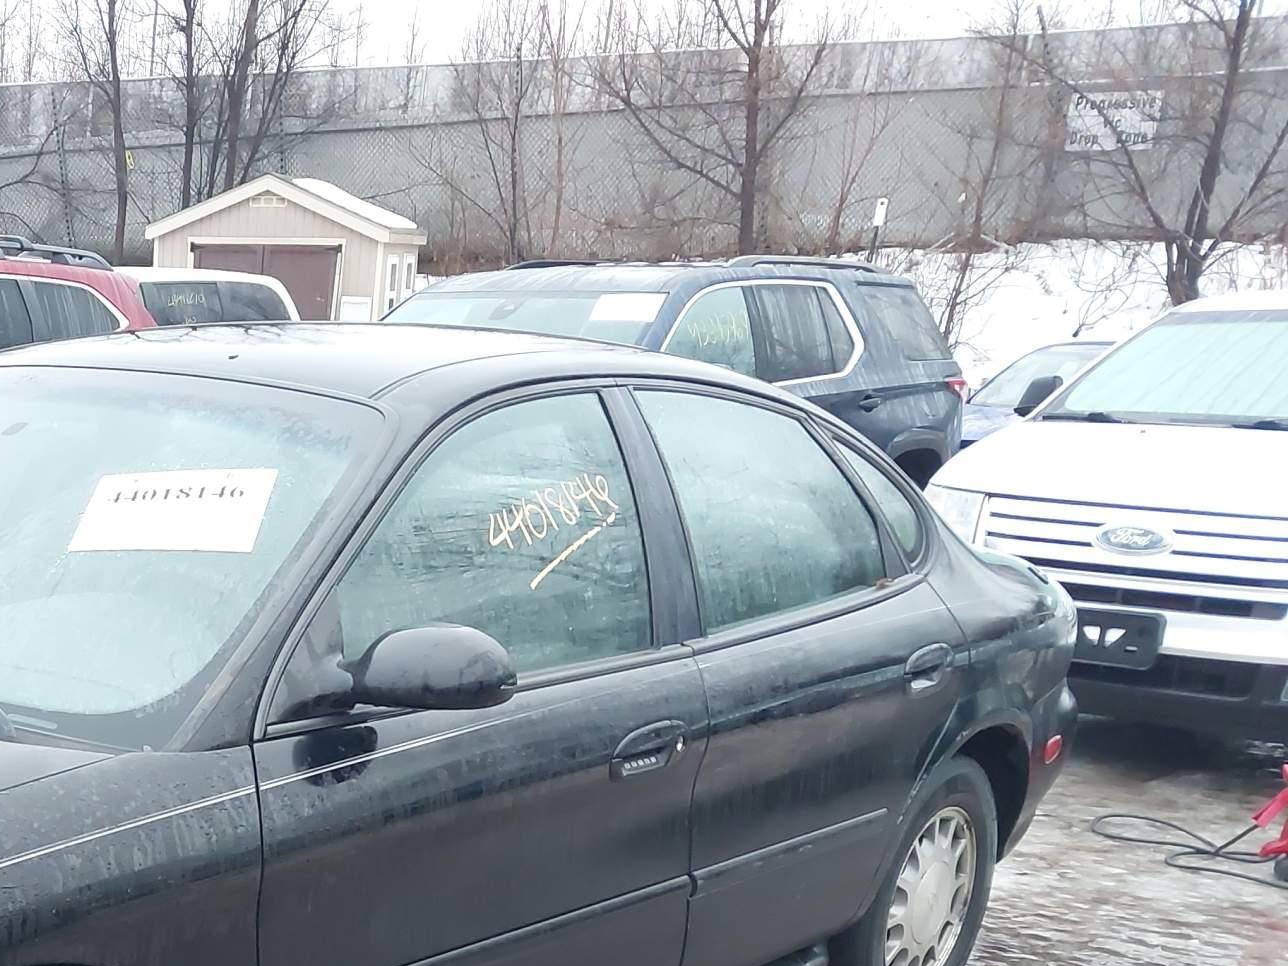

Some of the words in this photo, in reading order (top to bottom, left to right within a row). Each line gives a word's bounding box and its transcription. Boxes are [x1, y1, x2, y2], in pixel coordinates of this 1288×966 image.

[1070, 131, 1098, 147] Drop
[107, 485, 245, 503] 44018146
[487, 473, 619, 549] 44018146
[1111, 528, 1153, 546] Ford
